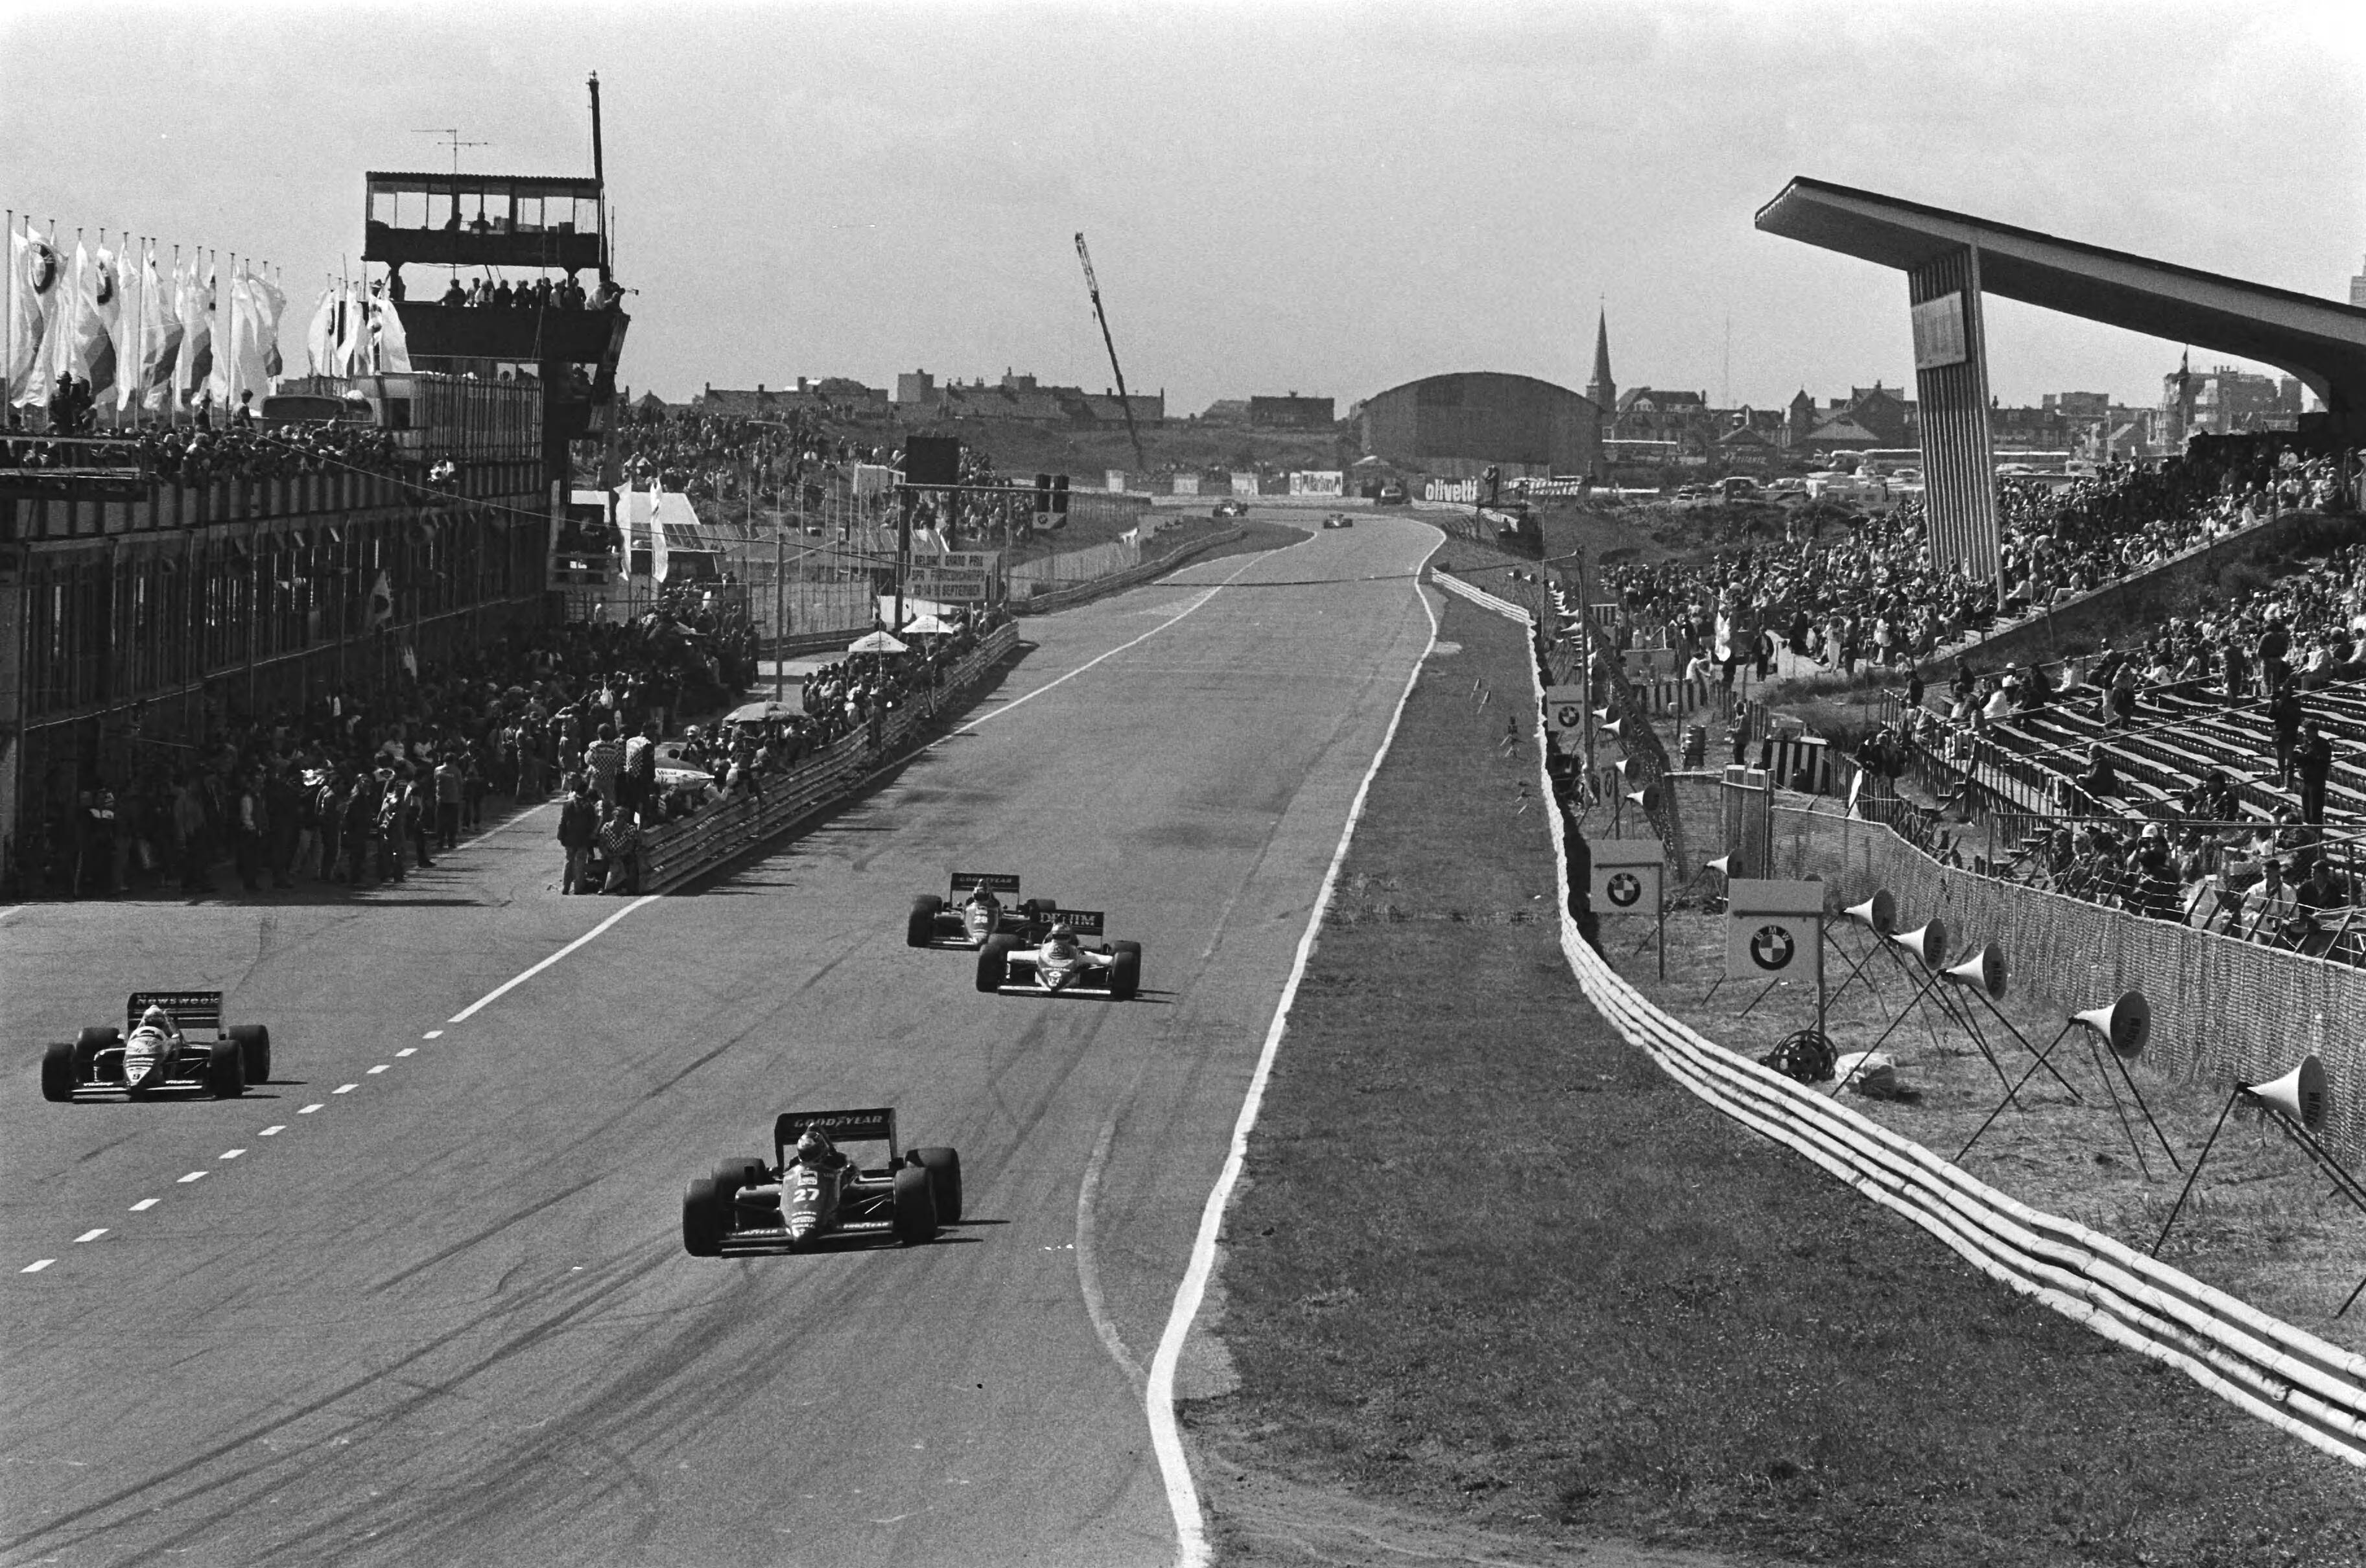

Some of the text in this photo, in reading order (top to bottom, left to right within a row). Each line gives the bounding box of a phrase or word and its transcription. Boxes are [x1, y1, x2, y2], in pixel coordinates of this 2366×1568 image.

[1425, 476, 1478, 502] olivetti
[945, 555, 966, 567] GRAND
[969, 555, 984, 567] PRIX
[942, 584, 980, 596] SEPTEMBER
[794, 1114, 883, 1129] GOODYEAR
[793, 1188, 820, 1202] 27
